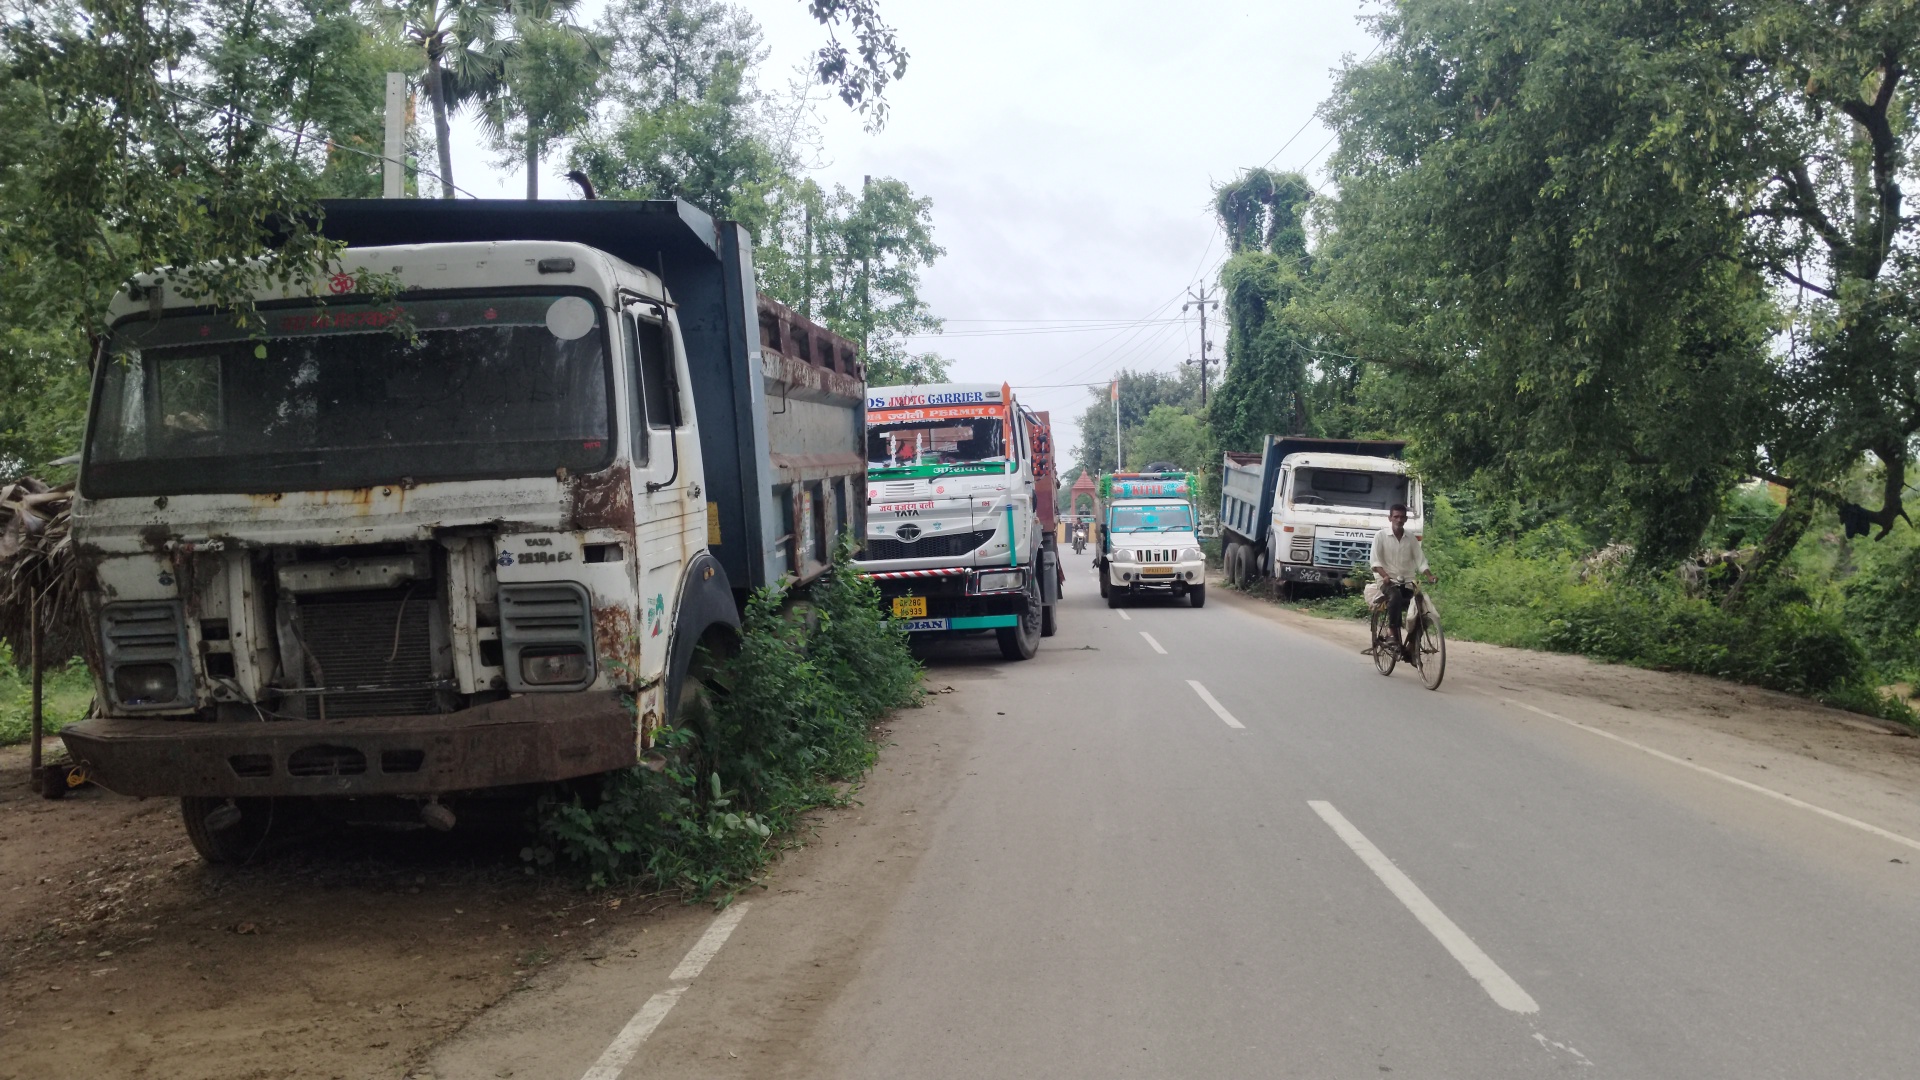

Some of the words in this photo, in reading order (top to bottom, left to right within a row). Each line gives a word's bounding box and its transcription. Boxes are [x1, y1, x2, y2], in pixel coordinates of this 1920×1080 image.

[930, 408, 984, 416] PERMIT
[895, 509, 919, 517] TATA
[525, 538, 552, 546] TATA
